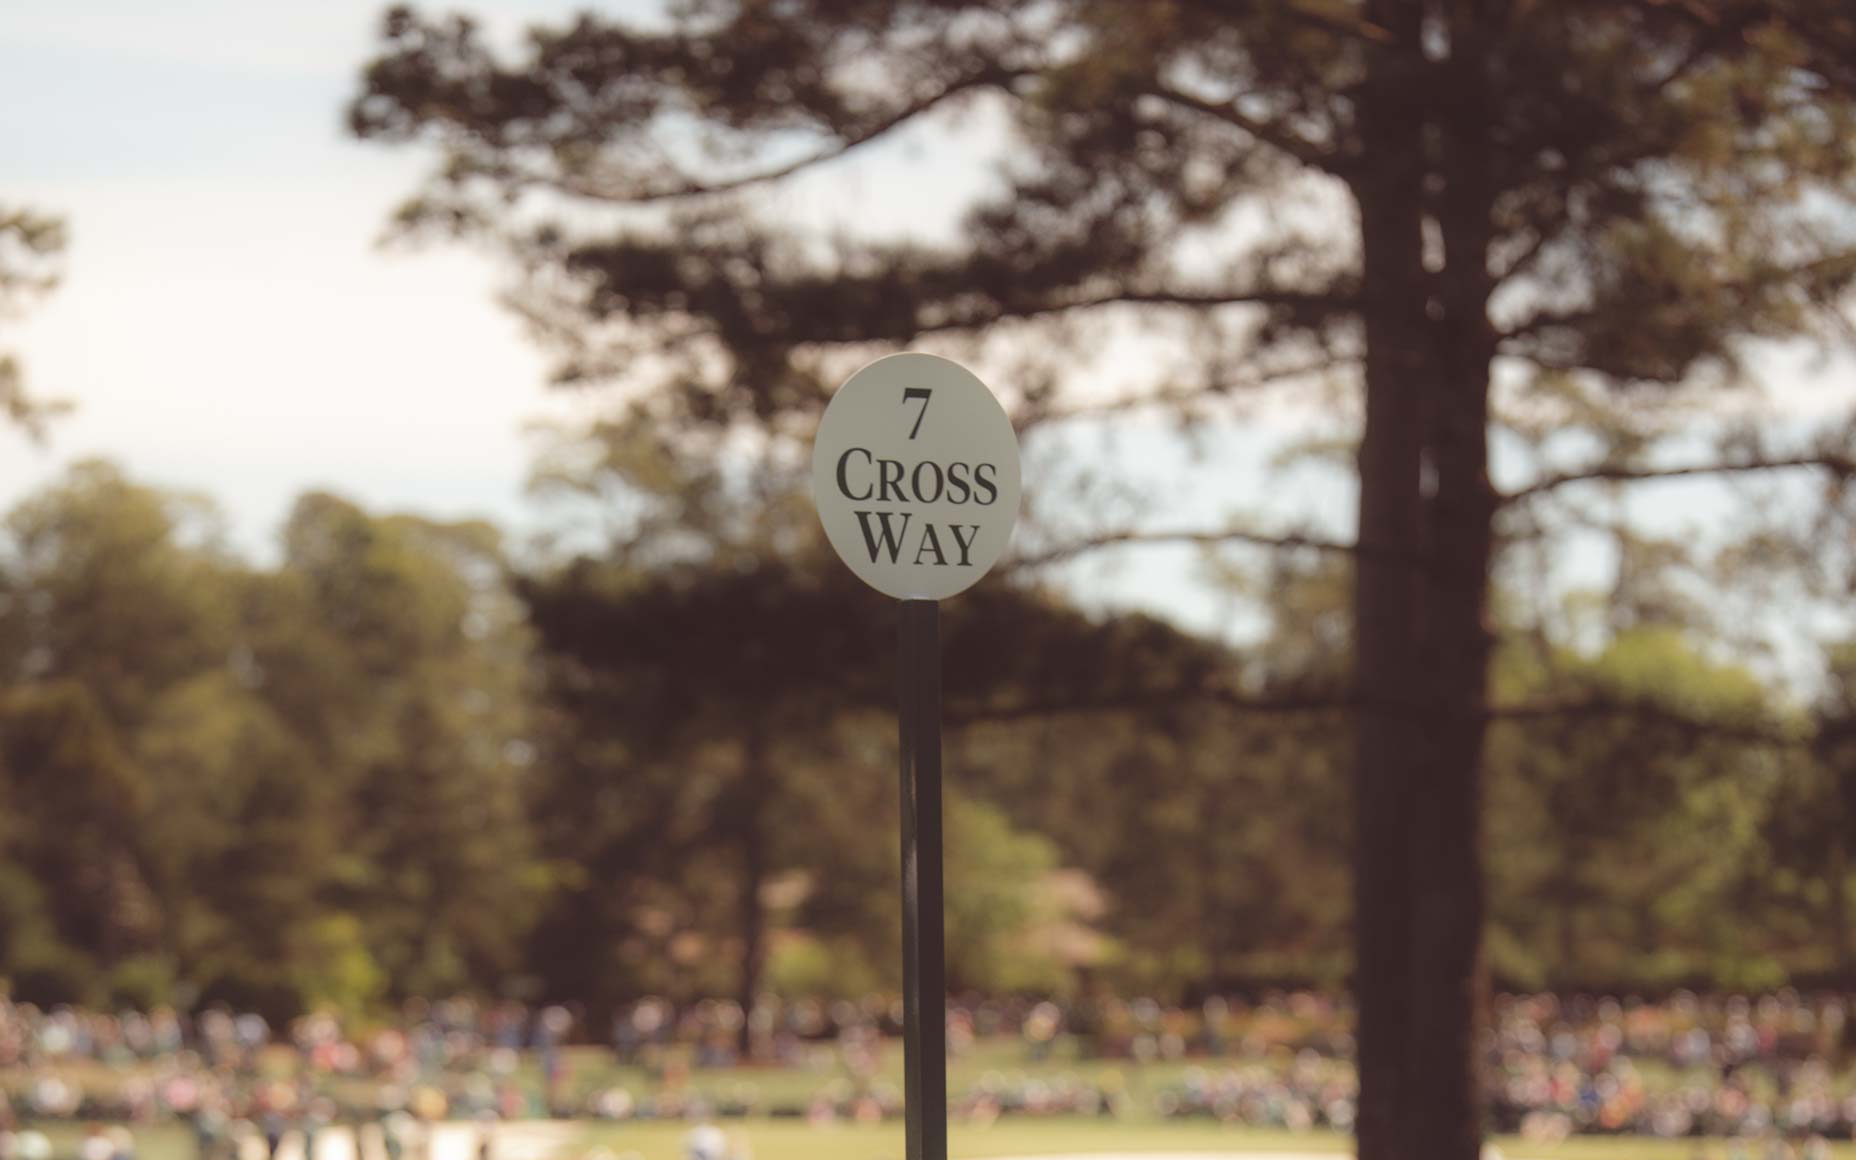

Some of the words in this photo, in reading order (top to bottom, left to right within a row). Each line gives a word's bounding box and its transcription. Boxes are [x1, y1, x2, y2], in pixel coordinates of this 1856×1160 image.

[902, 387, 933, 440] 7
[835, 447, 998, 506] CROSS
[853, 510, 981, 567] WAY
